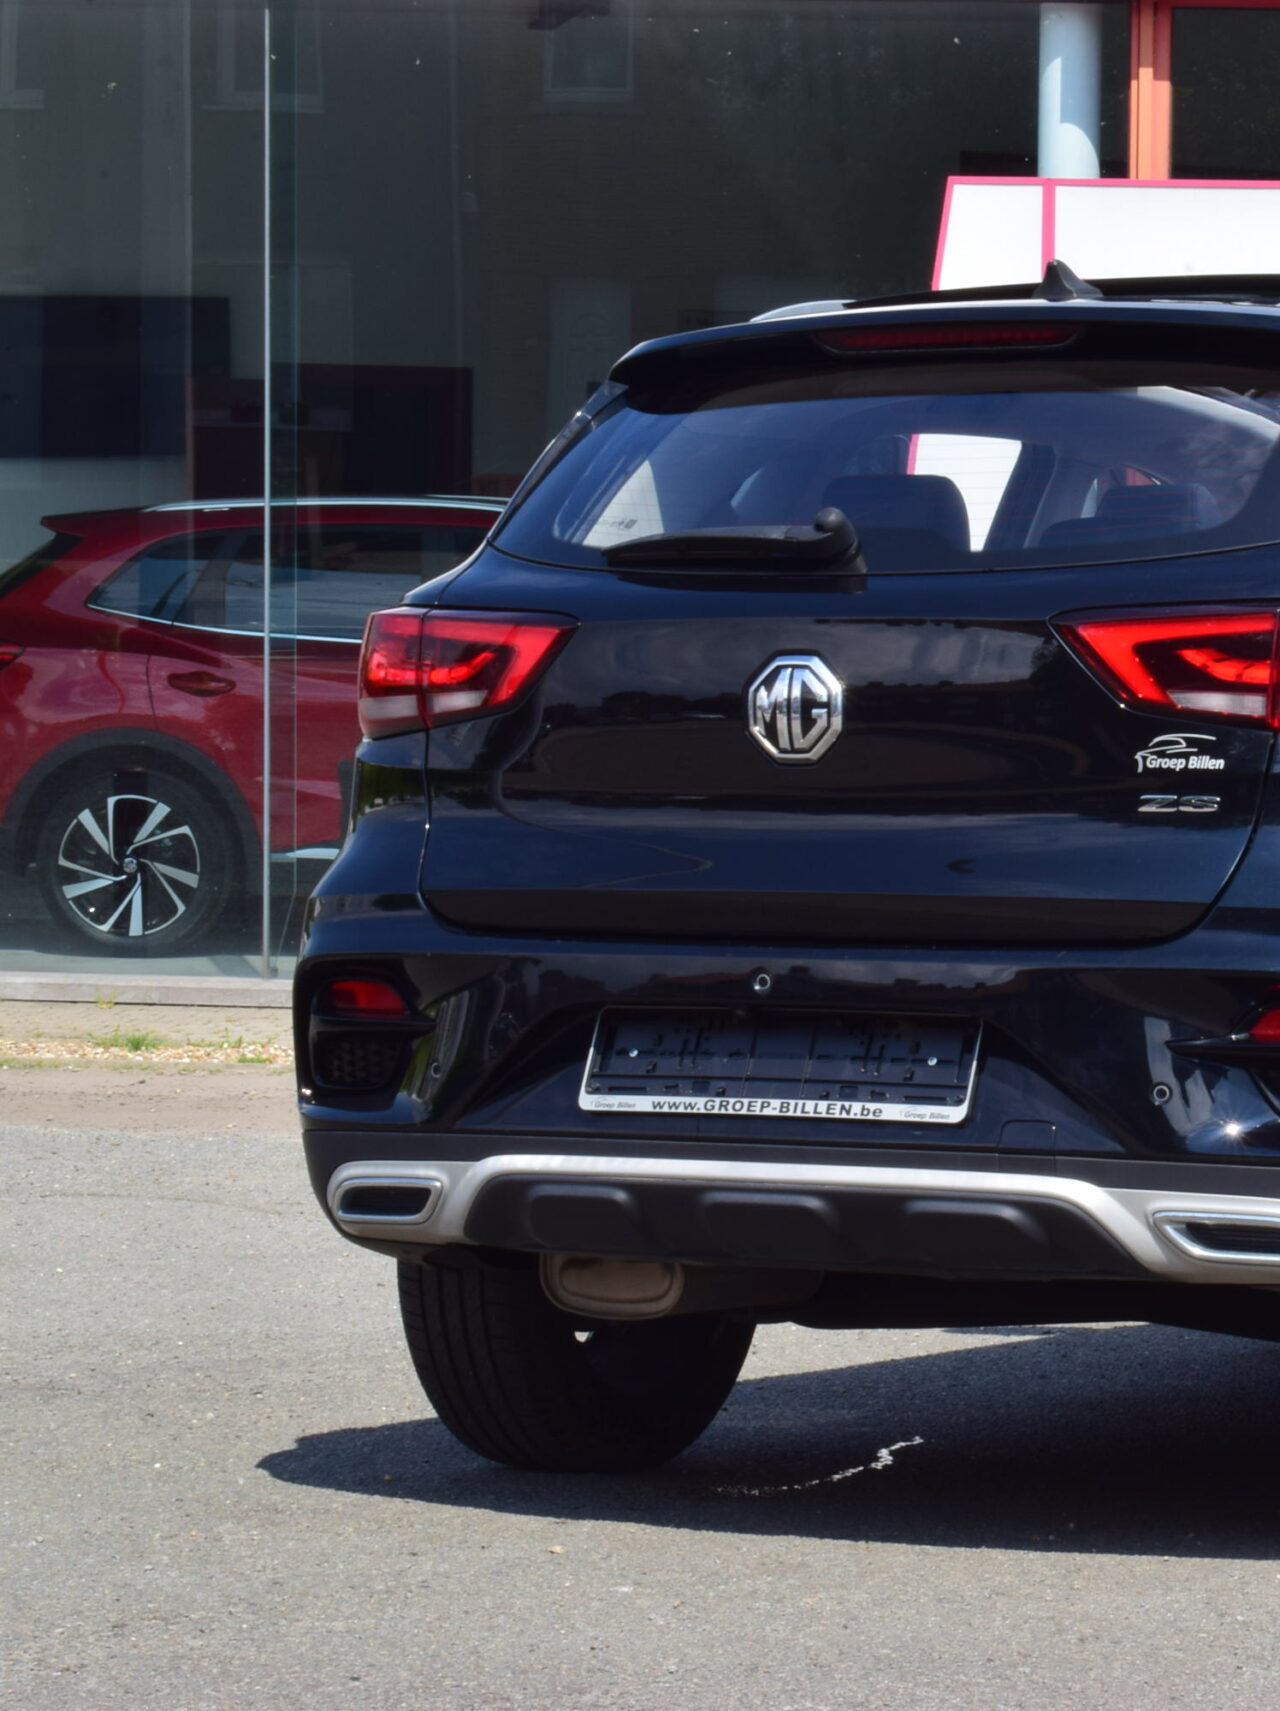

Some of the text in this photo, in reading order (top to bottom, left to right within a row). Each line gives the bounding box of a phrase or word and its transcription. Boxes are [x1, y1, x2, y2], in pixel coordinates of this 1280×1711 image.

[755, 665, 830, 752] MG
[1146, 754, 1225, 772] Groep Billen
[1137, 794, 1221, 812] ZS
[652, 1099, 883, 1118] www.GROEP-BILLEN.be
